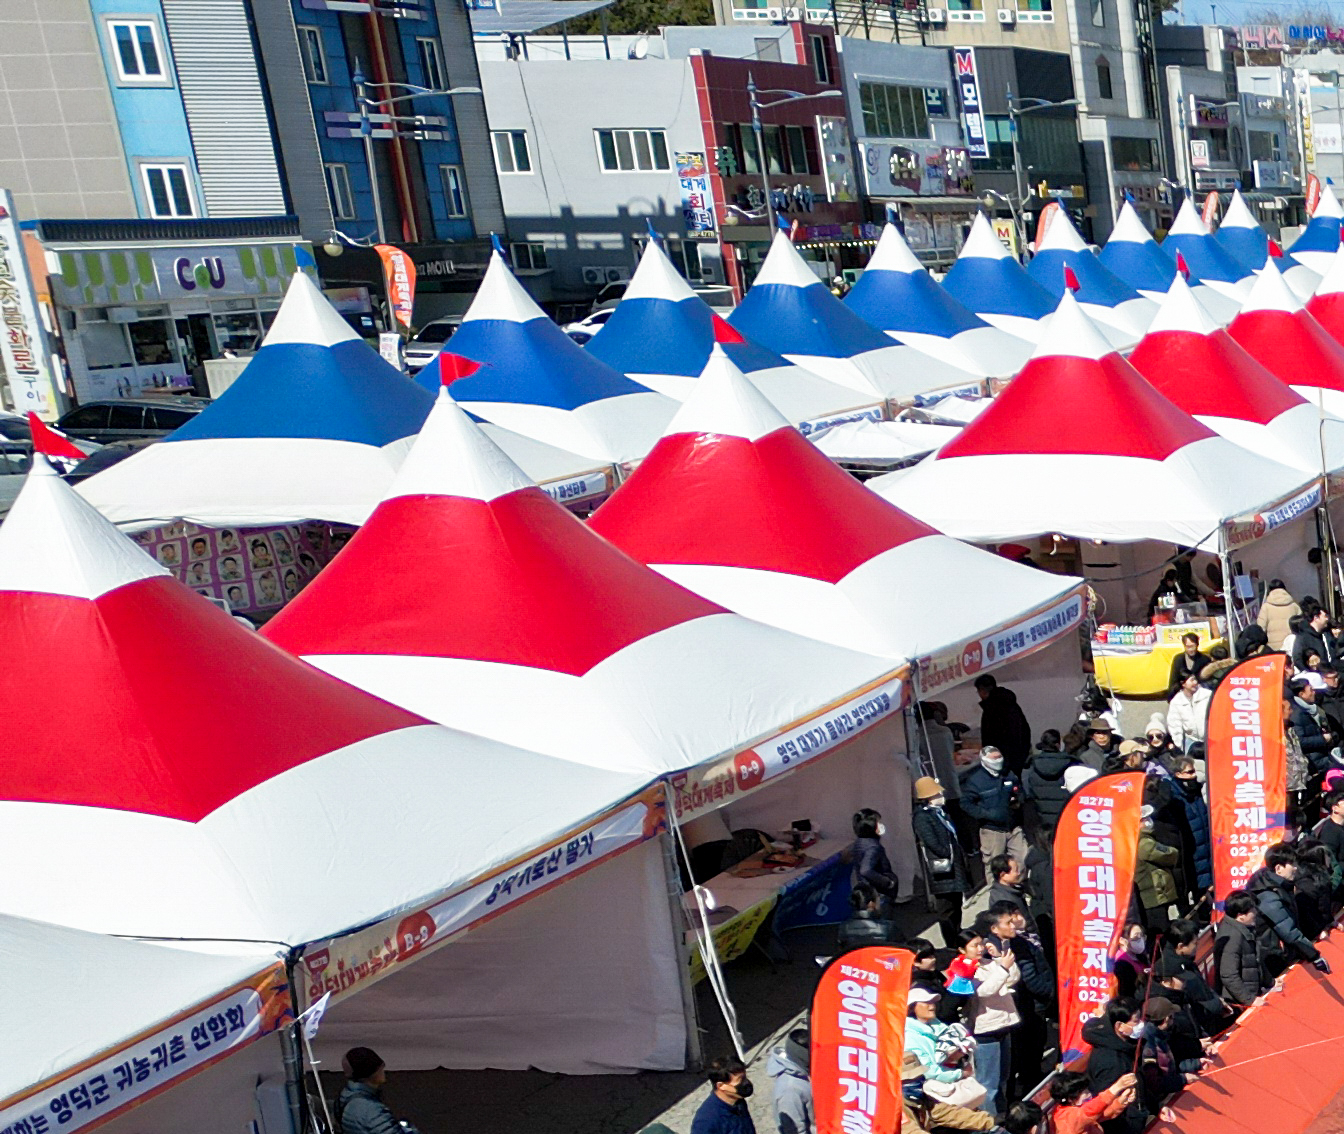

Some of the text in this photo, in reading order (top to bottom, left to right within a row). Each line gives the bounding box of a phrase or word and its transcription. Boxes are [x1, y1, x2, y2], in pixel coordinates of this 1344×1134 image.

[956, 53, 974, 75] M
[174, 255, 226, 291] CU
[1229, 676, 1261, 686] 제27회
[776, 740, 801, 765] 영덕
[1229, 687, 1267, 829] 영덕대게축제
[739, 759, 760, 780] B-9
[1078, 796, 1114, 808] 제27회
[564, 831, 594, 866] 딸기
[840, 964, 880, 985] 제27회
[49, 1073, 111, 1125] 영덕군
[112, 1033, 187, 1091] 귀농귀촌
[189, 1003, 246, 1052] 연합회
